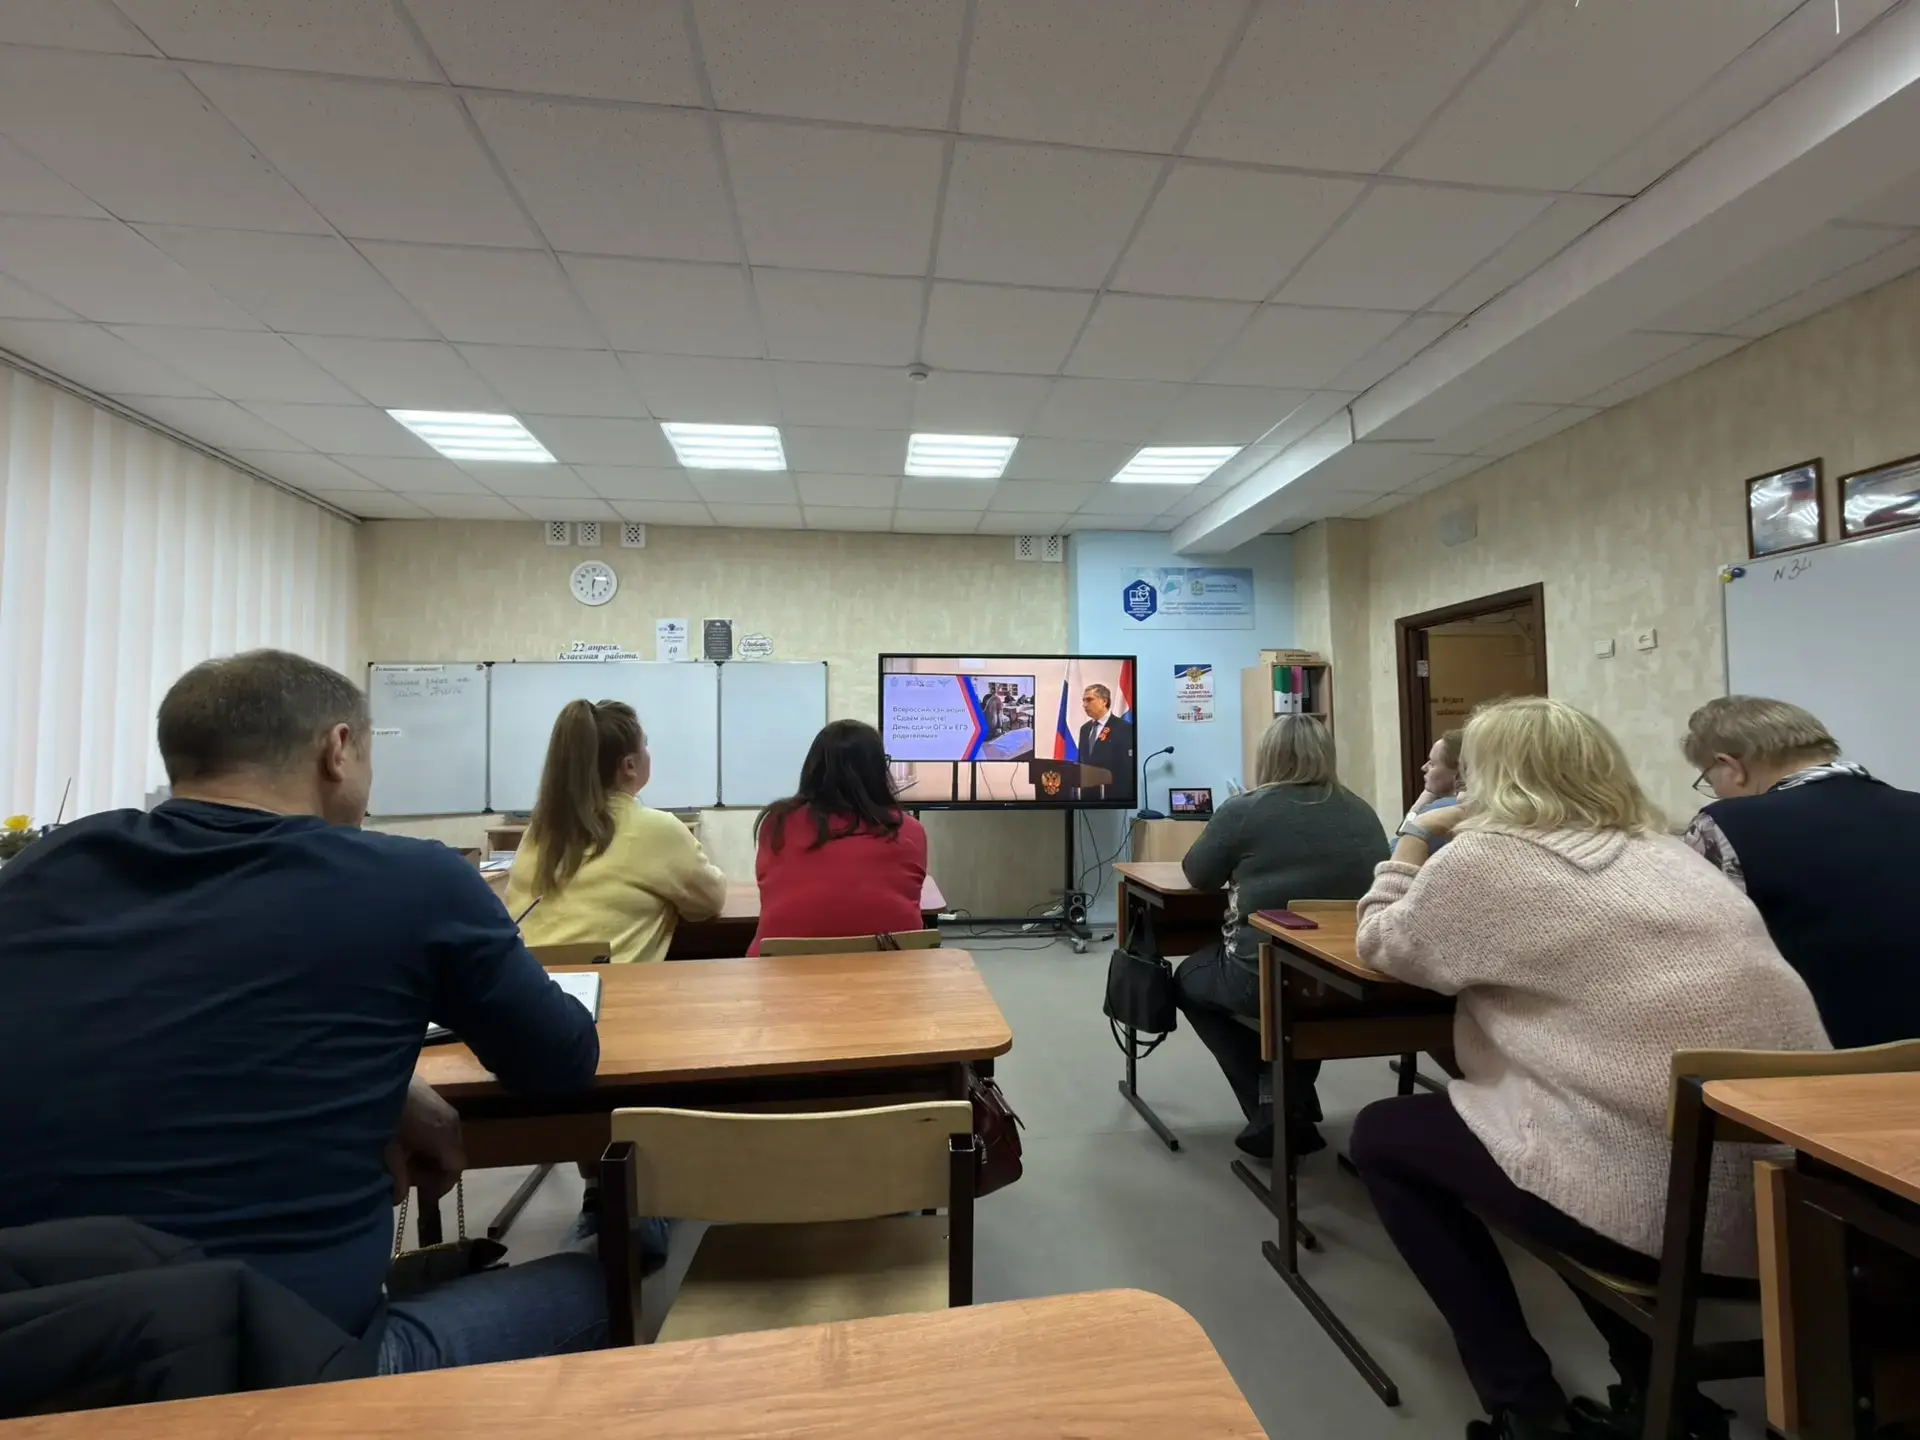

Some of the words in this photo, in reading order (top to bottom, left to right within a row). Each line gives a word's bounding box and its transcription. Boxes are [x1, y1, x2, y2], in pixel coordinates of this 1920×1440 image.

[573, 643, 585, 652] 22
[587, 645, 620, 653] апреля.
[559, 652, 599, 661] Классная
[603, 652, 639, 663] работа.
